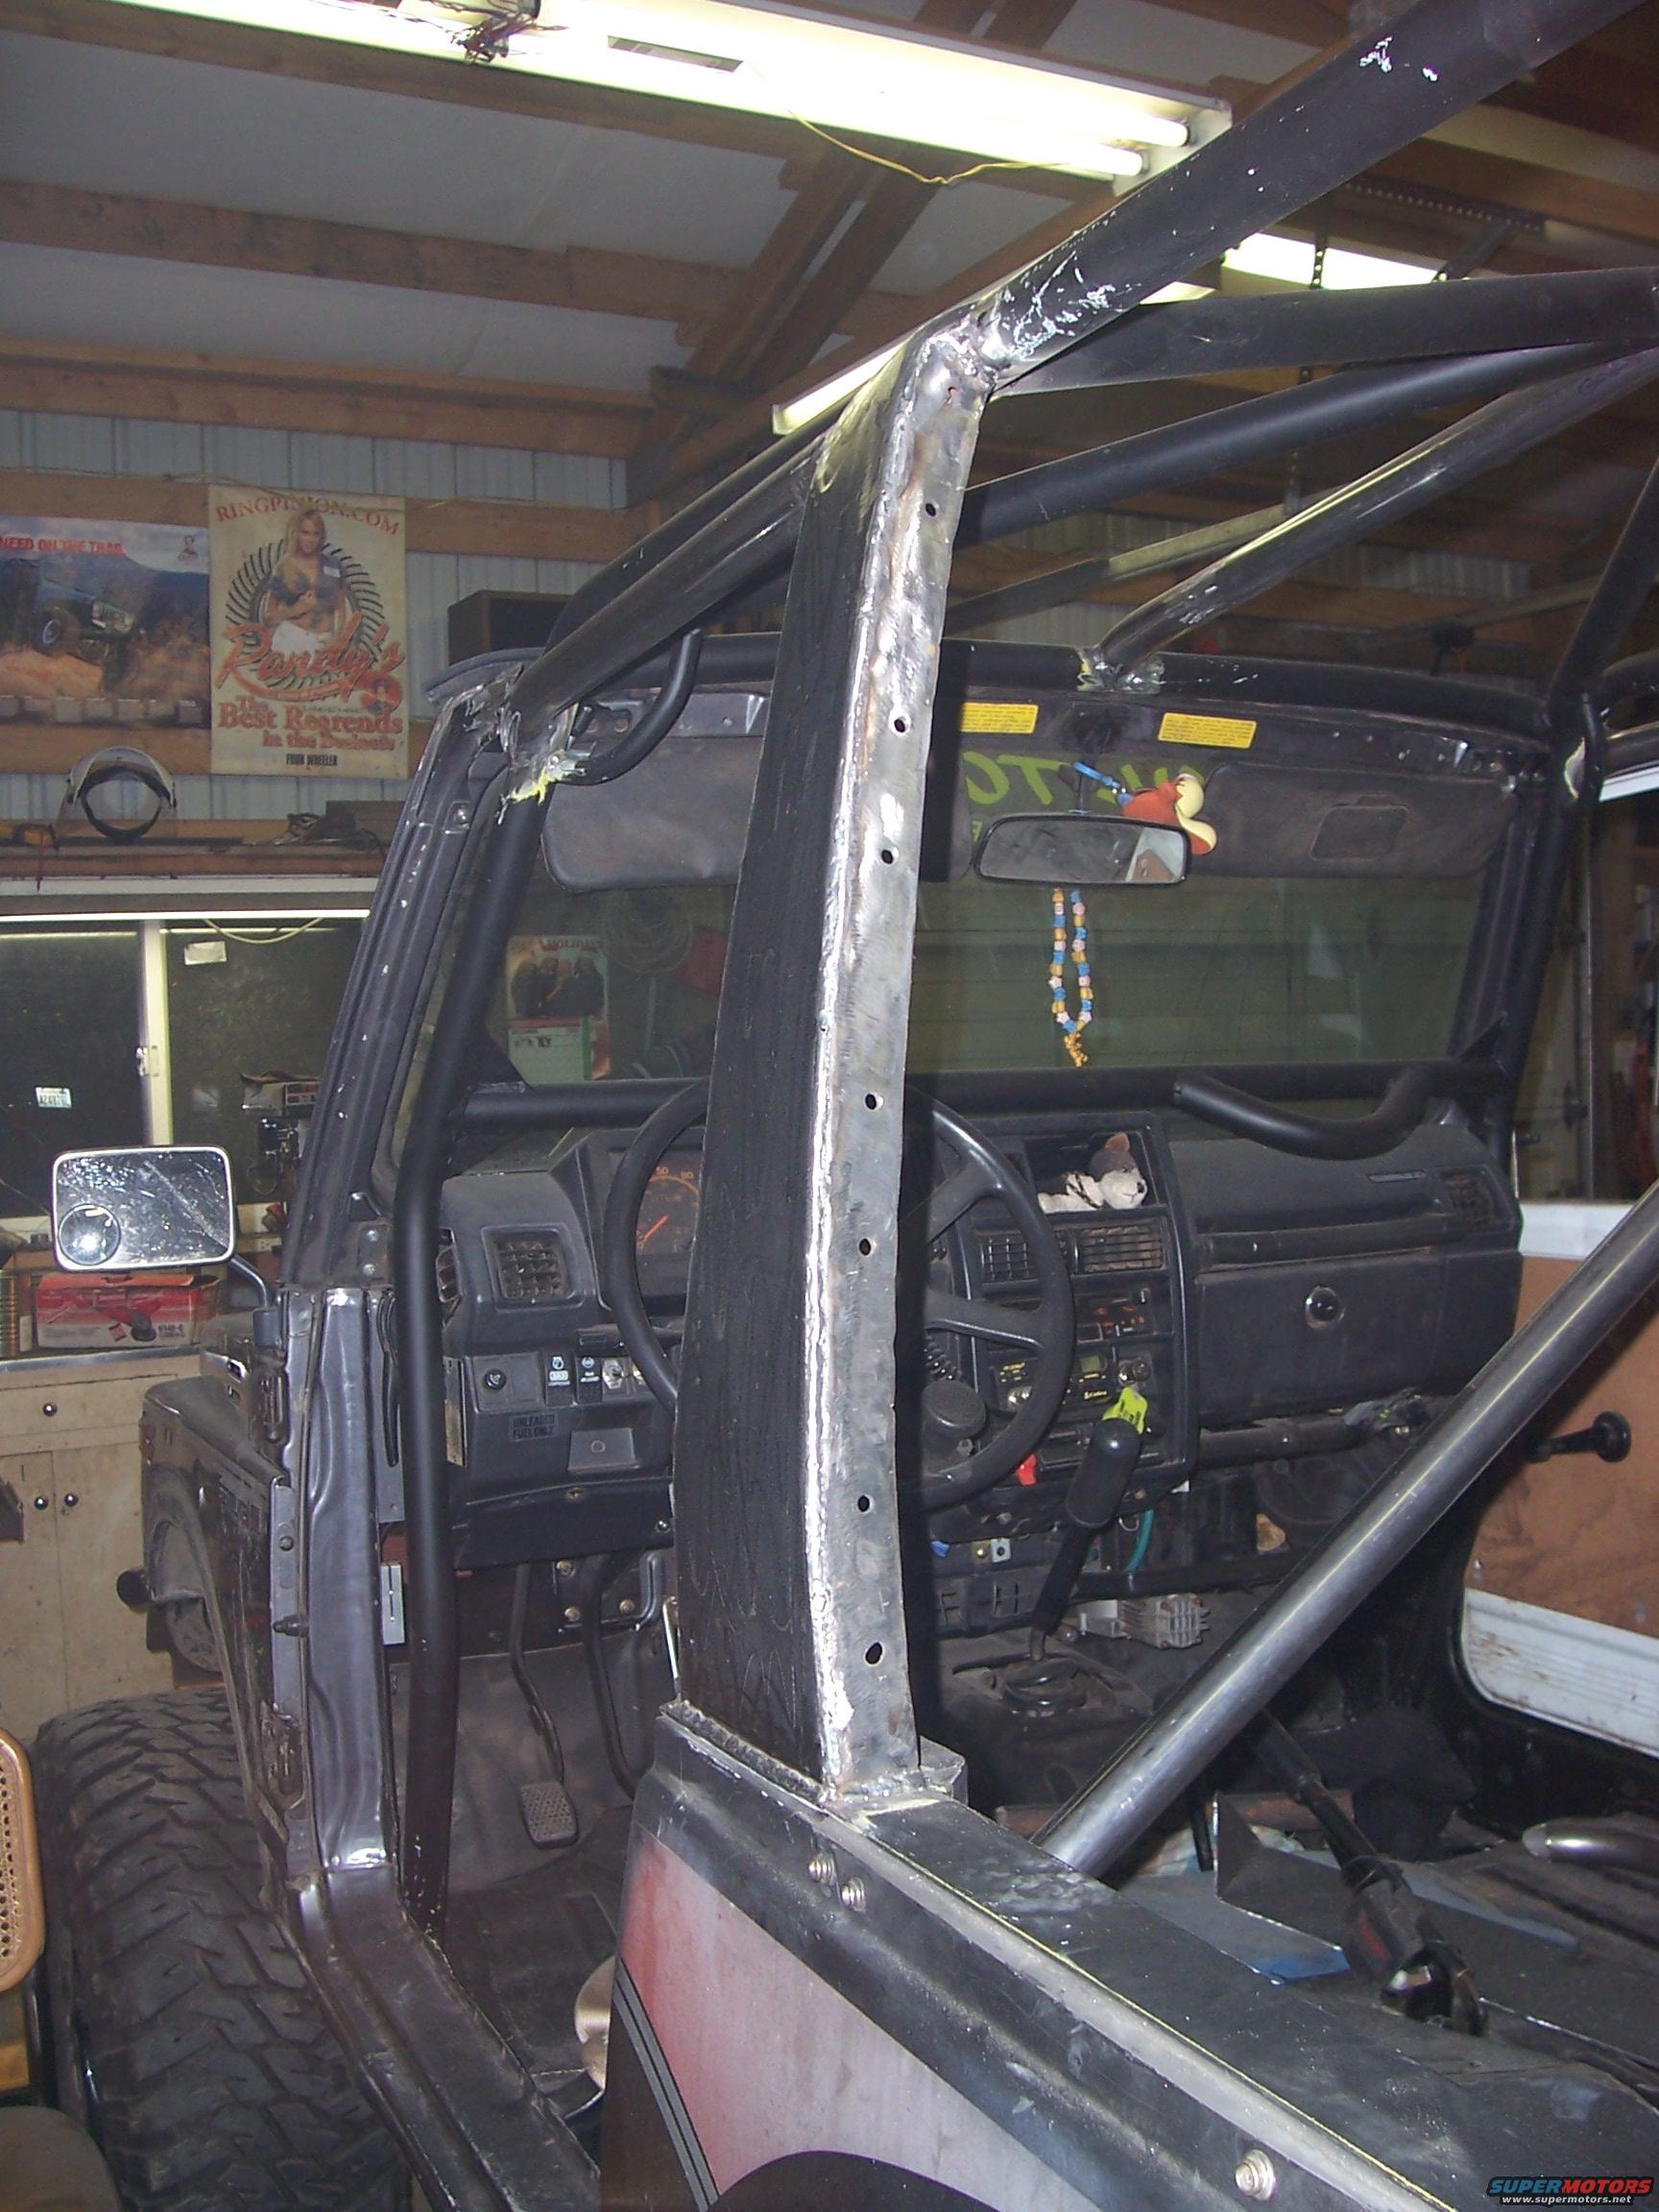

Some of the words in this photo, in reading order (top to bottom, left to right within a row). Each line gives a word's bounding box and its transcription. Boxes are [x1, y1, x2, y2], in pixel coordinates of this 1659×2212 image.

[214, 611, 406, 703] Randy's
[218, 701, 277, 730] Best
[287, 732, 317, 749] the
